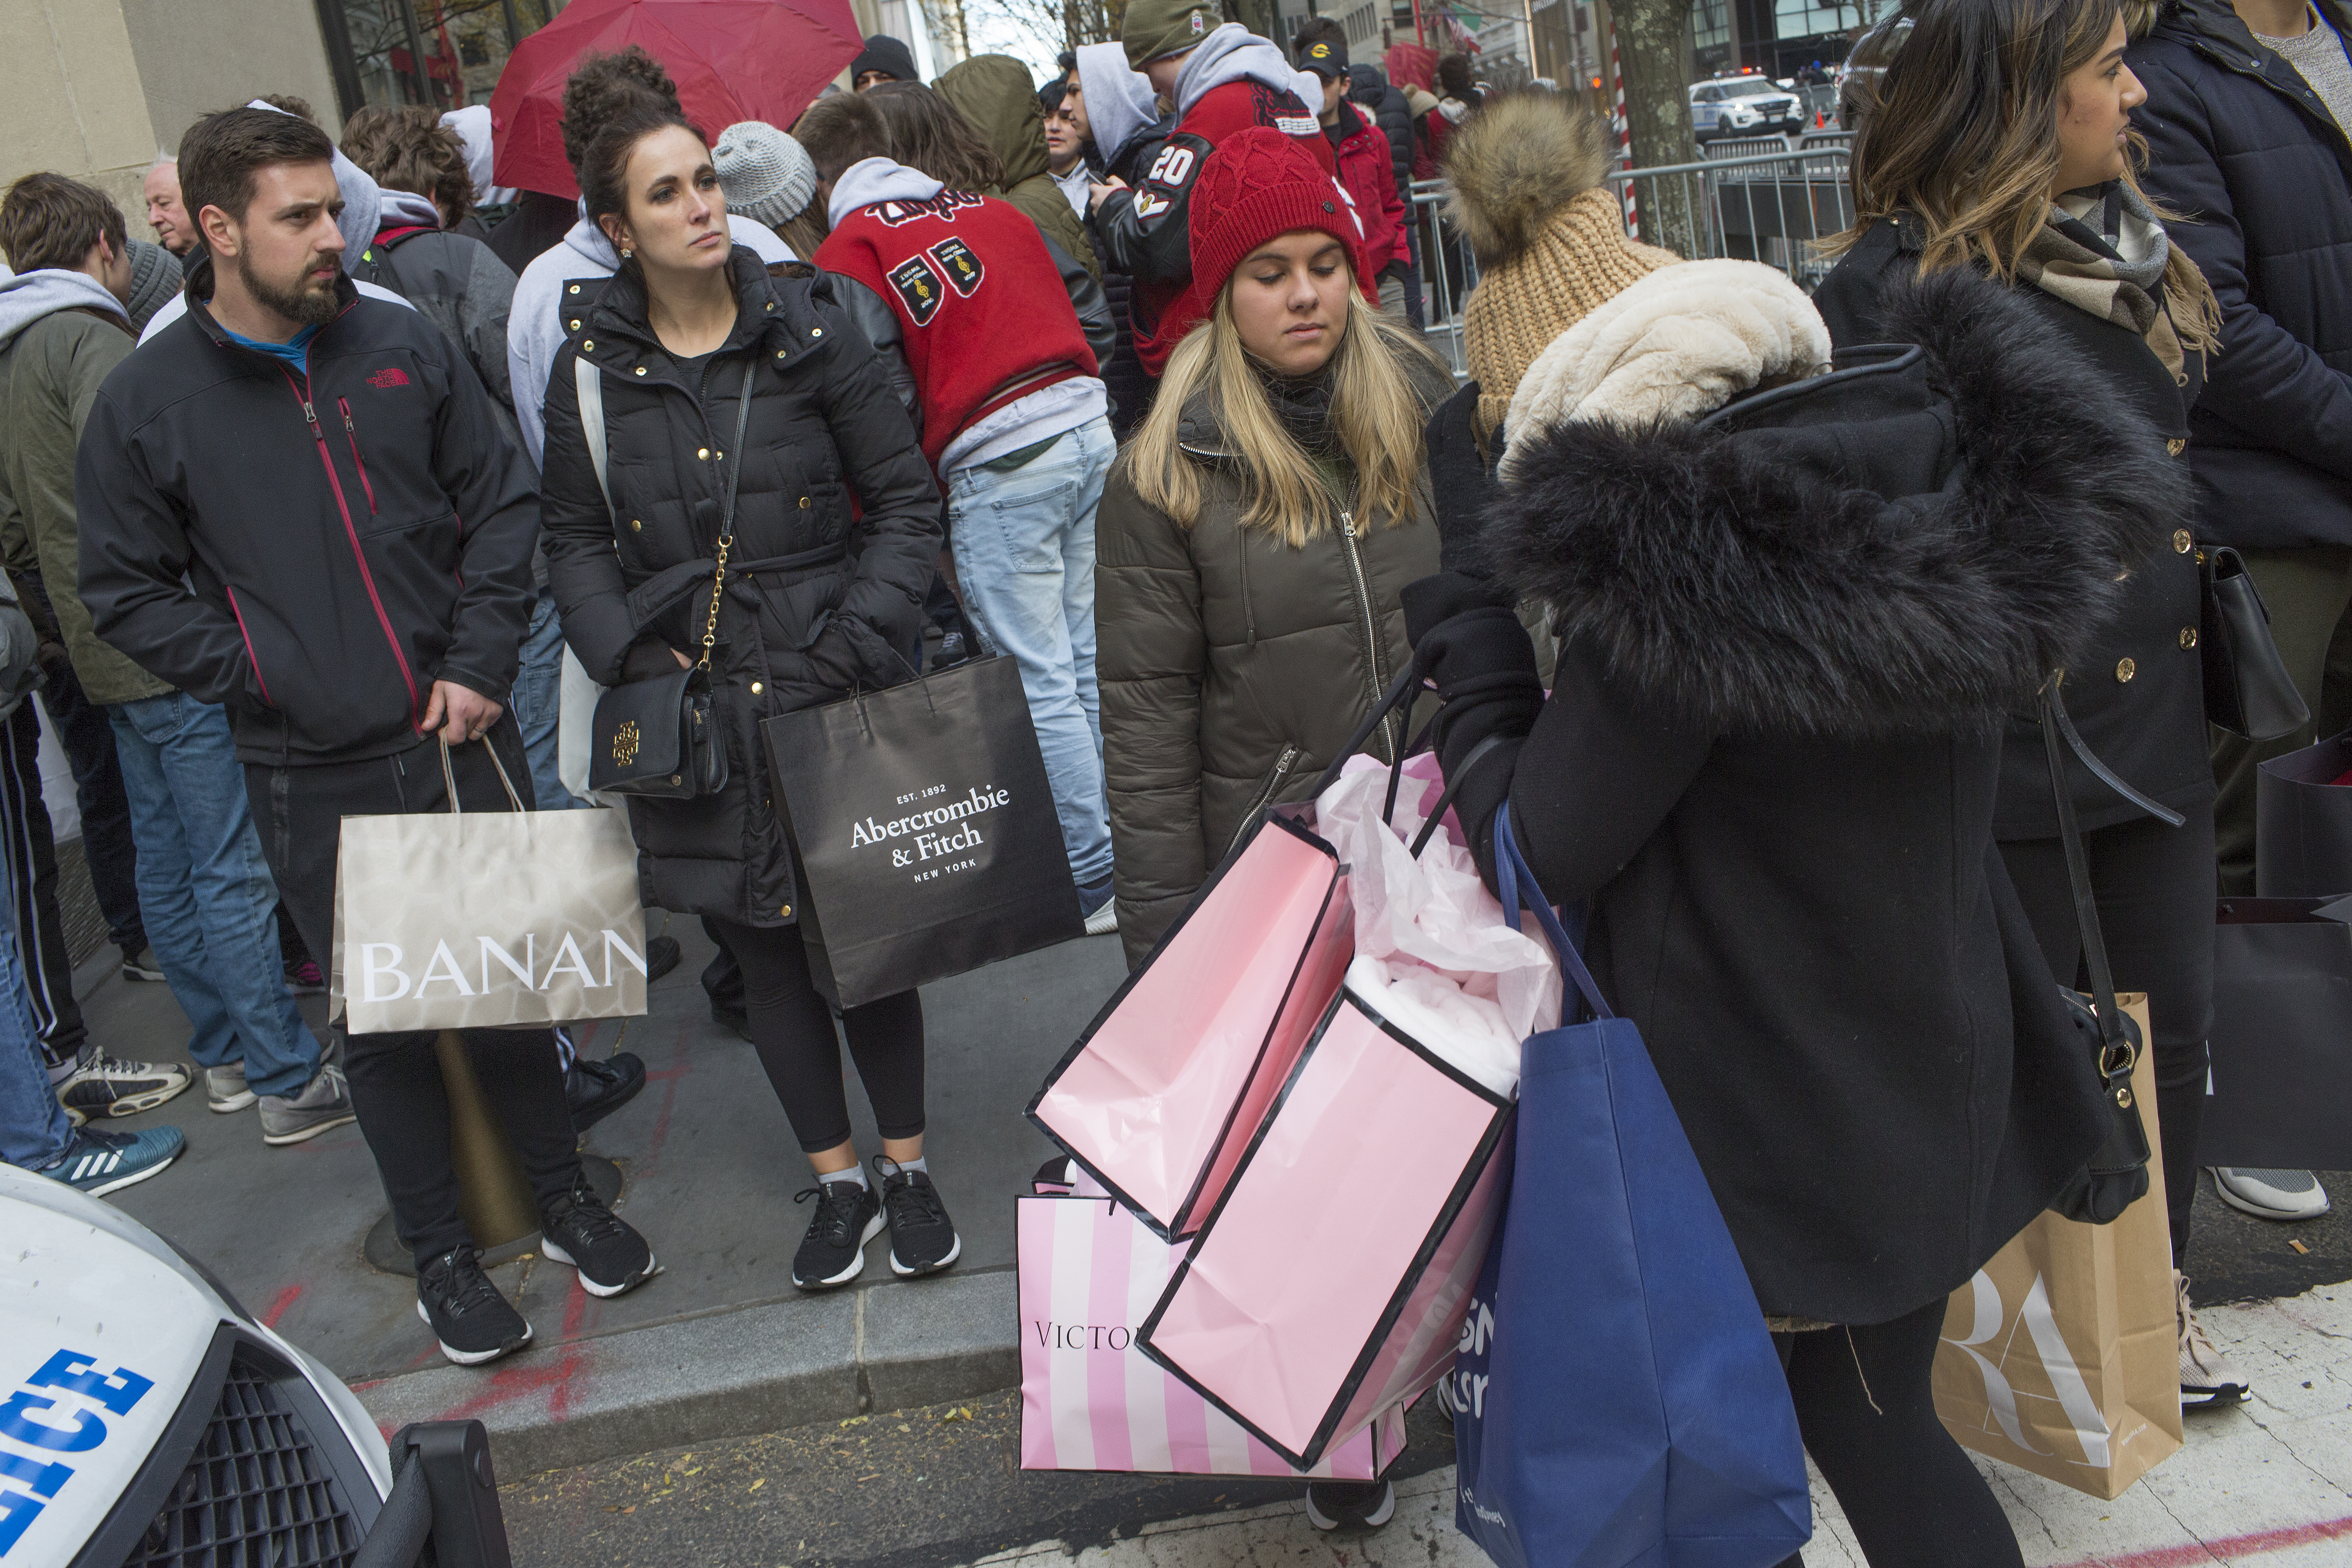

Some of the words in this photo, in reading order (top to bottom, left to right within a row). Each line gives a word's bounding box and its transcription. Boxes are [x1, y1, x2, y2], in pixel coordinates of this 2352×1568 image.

[1148, 145, 1194, 186] 20
[899, 265, 921, 281] ISSMA
[964, 271, 976, 281] 2017
[921, 297, 934, 309] 2016
[366, 374, 396, 384] NORTH
[376, 368, 393, 377] THE
[376, 380, 397, 389] FACE
[896, 793, 918, 805] EST.
[921, 784, 946, 798] 1892
[851, 784, 1009, 849] Abercrombie
[892, 849, 913, 867] &
[913, 821, 984, 861] Fitch
[914, 869, 939, 883] NEW
[944, 858, 977, 874] YORK
[1034, 1321, 1140, 1351] VICTO
